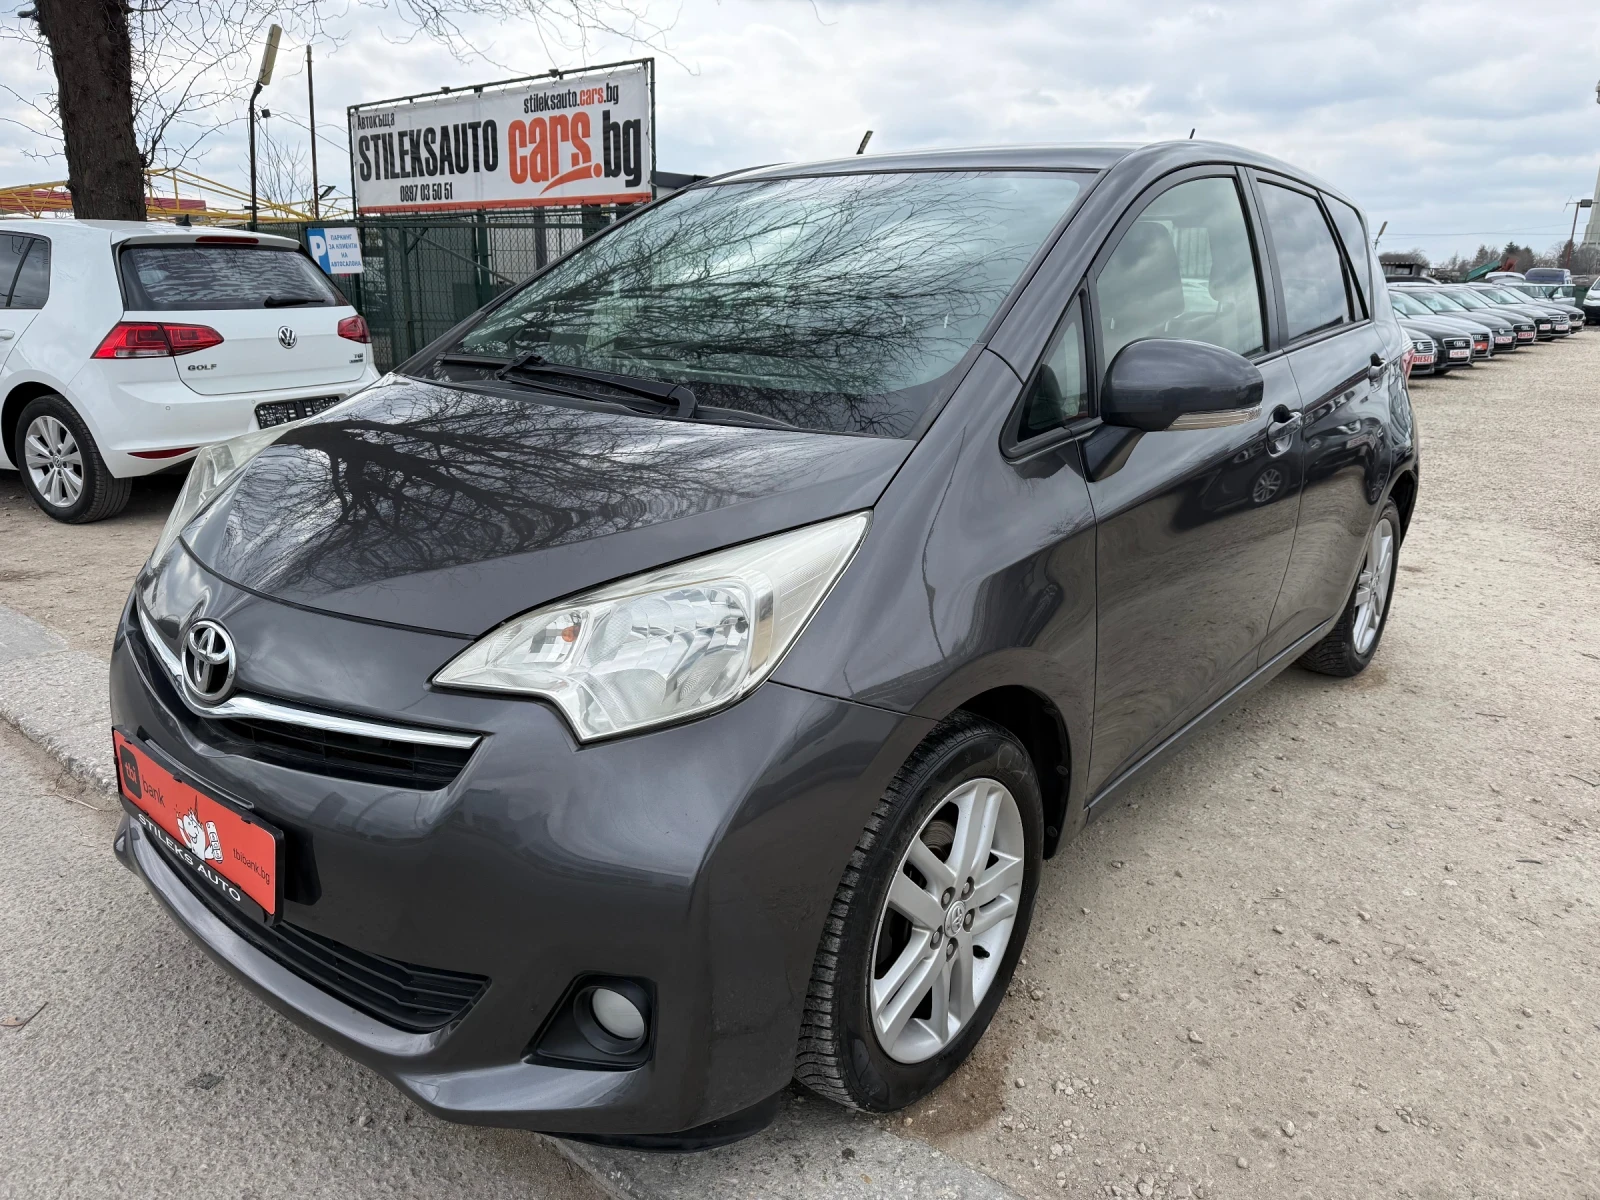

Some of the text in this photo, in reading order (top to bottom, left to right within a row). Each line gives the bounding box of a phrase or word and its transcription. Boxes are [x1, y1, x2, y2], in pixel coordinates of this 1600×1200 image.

[523, 82, 619, 114] stileksauto.cars.bg
[357, 112, 395, 130] Автокъща
[358, 119, 499, 181] STILEKSAUTO
[508, 110, 642, 188] cars.bg
[420, 184, 430, 201] 03
[432, 183, 442, 200] 50
[444, 182, 453, 199] 51
[187, 363, 217, 371] GOLF
[1412, 355, 1433, 363] DIESEL
[125, 762, 165, 807] tbi bank
[138, 813, 241, 902] STILEKS AUTO
[232, 848, 270, 886] tbibank.bg
